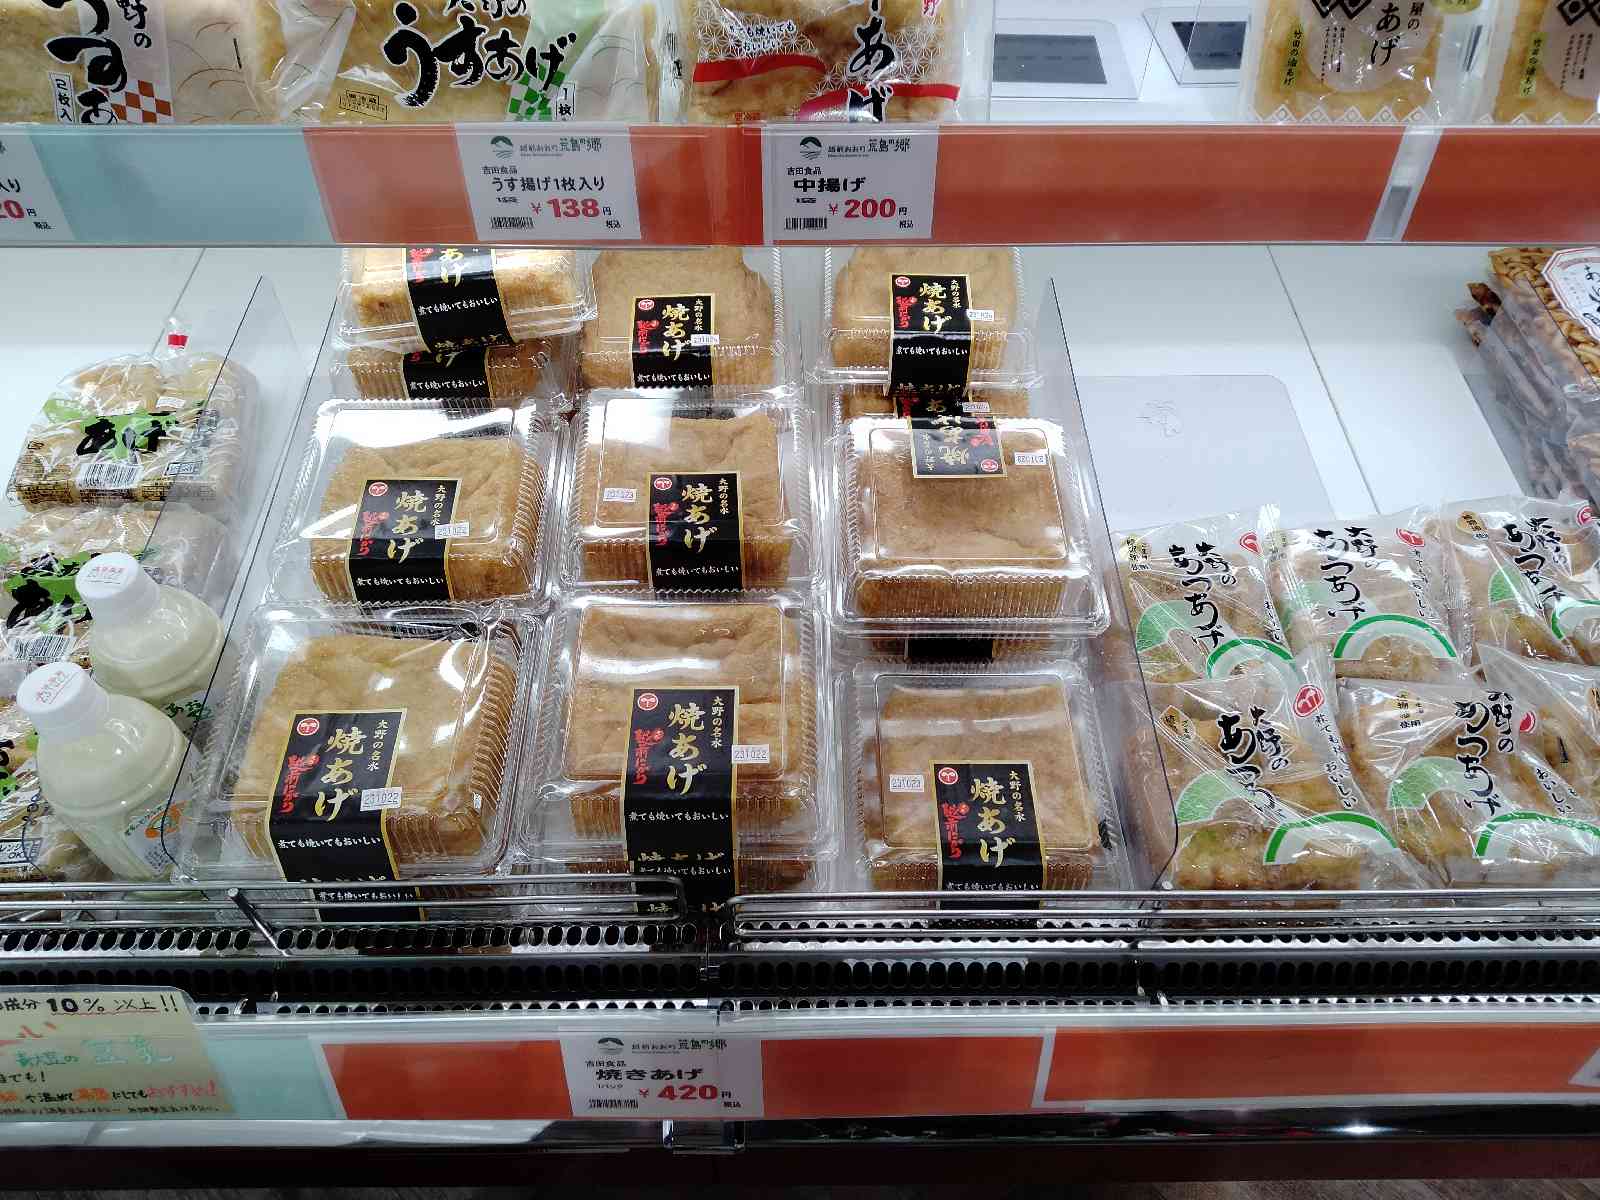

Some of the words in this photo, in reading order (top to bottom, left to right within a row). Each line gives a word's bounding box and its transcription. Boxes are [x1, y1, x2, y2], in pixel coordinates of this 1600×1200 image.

[382, 0, 578, 108] うすあげ
[1370, 4, 1400, 66] あげ
[491, 176, 606, 192] うす揚げ1枚入り
[786, 166, 822, 175] 吉田食品
[793, 177, 867, 193] 中揚げ
[416, 296, 499, 316] 煮ても焼いてもおいしい
[919, 282, 952, 334] 焼あげ
[662, 303, 691, 362] 焼あげ
[896, 346, 968, 356] 煮ても焼いてもおいしい
[388, 490, 429, 564] 焼あげ
[681, 482, 718, 553] 焼あげ
[356, 577, 444, 586] 煮ても焼いてもおいしい
[1168, 544, 1225, 649] あつあげ
[1313, 529, 1366, 621] あつあげ
[366, 719, 389, 772] 大野の名水
[710, 695, 725, 749] 大野の名水
[314, 726, 367, 822] 焼あげ
[665, 702, 709, 796] 焼あげ
[1454, 701, 1502, 817] あつあげ
[1008, 770, 1027, 822] 大野の名水
[1323, 761, 1358, 809] おいしい
[278, 835, 381, 849] 煮ても焼いてもおいしい
[628, 811, 729, 822] 煮ても焼いてもおいしい
[970, 776, 1018, 869] 焼あげ
[46, 997, 105, 1013] 10%
[112, 994, 180, 1013] 以上!!
[595, 1068, 705, 1081] 焼きあげ
